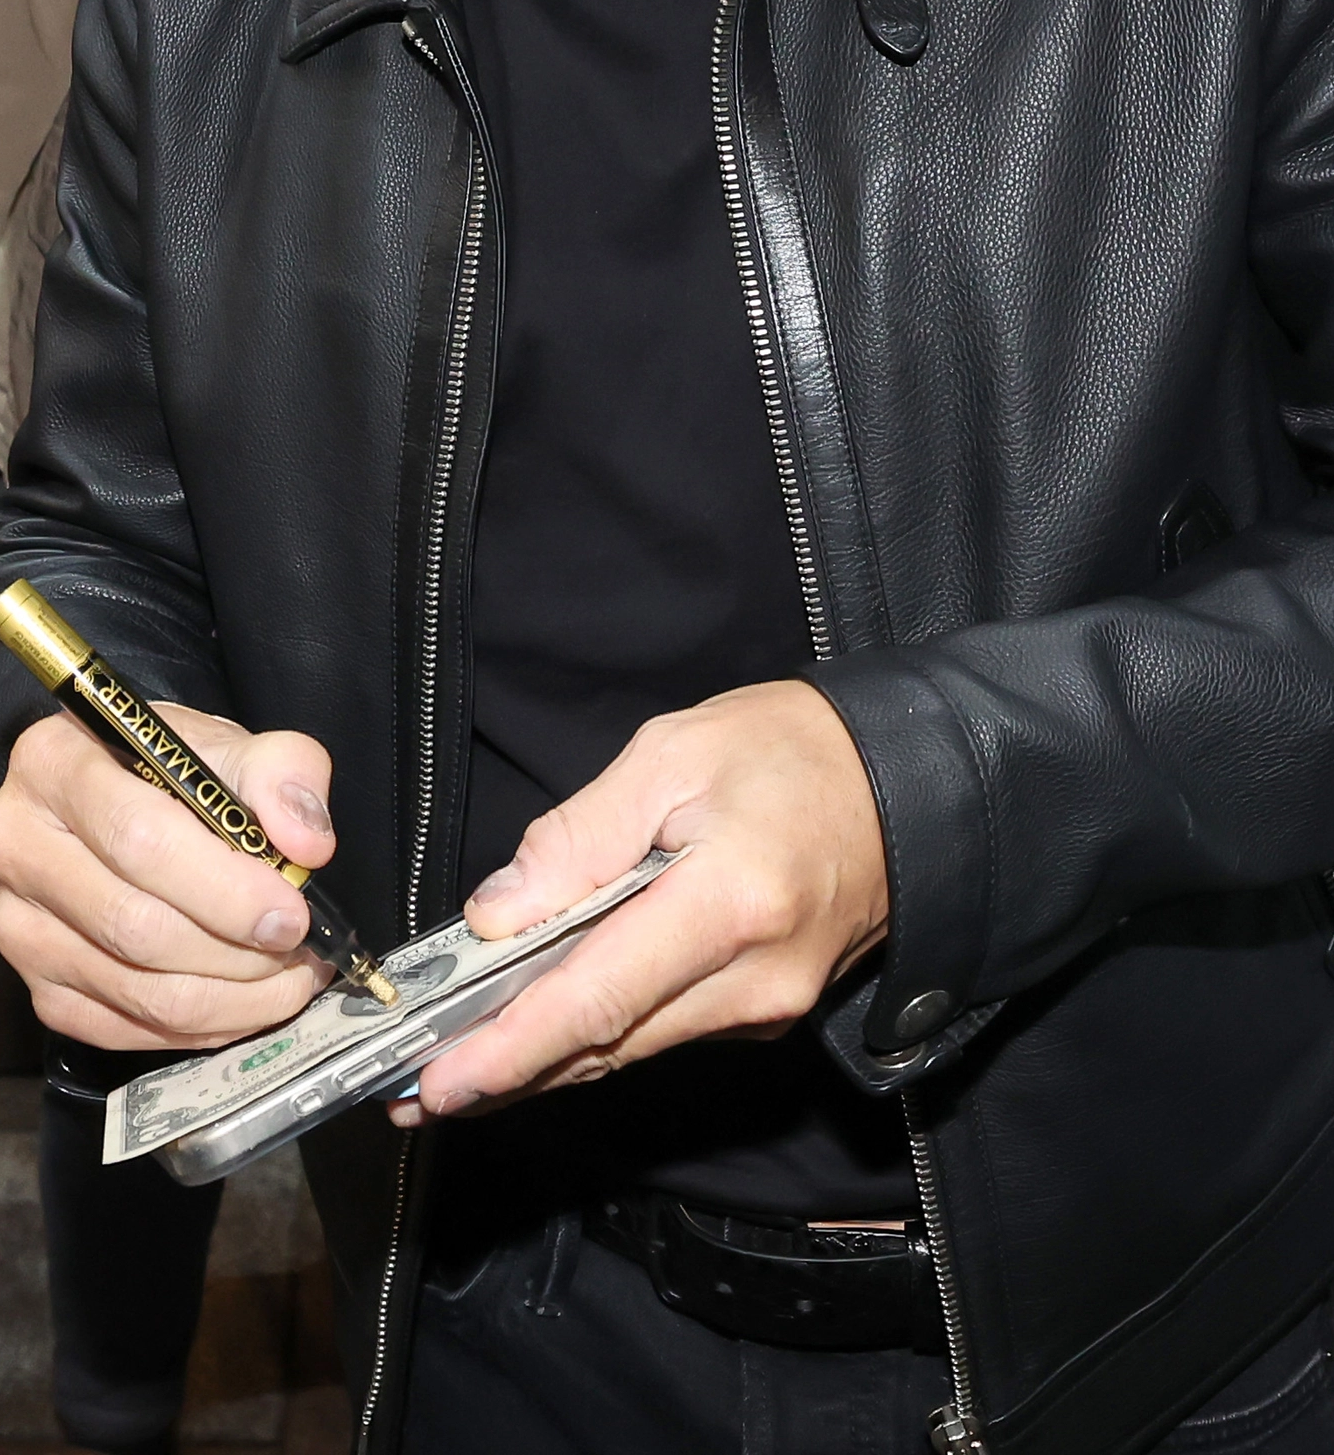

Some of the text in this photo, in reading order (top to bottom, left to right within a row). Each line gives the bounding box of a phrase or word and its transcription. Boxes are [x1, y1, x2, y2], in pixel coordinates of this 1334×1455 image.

[98, 677, 268, 853] GOLD MARKER
[133, 760, 172, 795] ILOT
